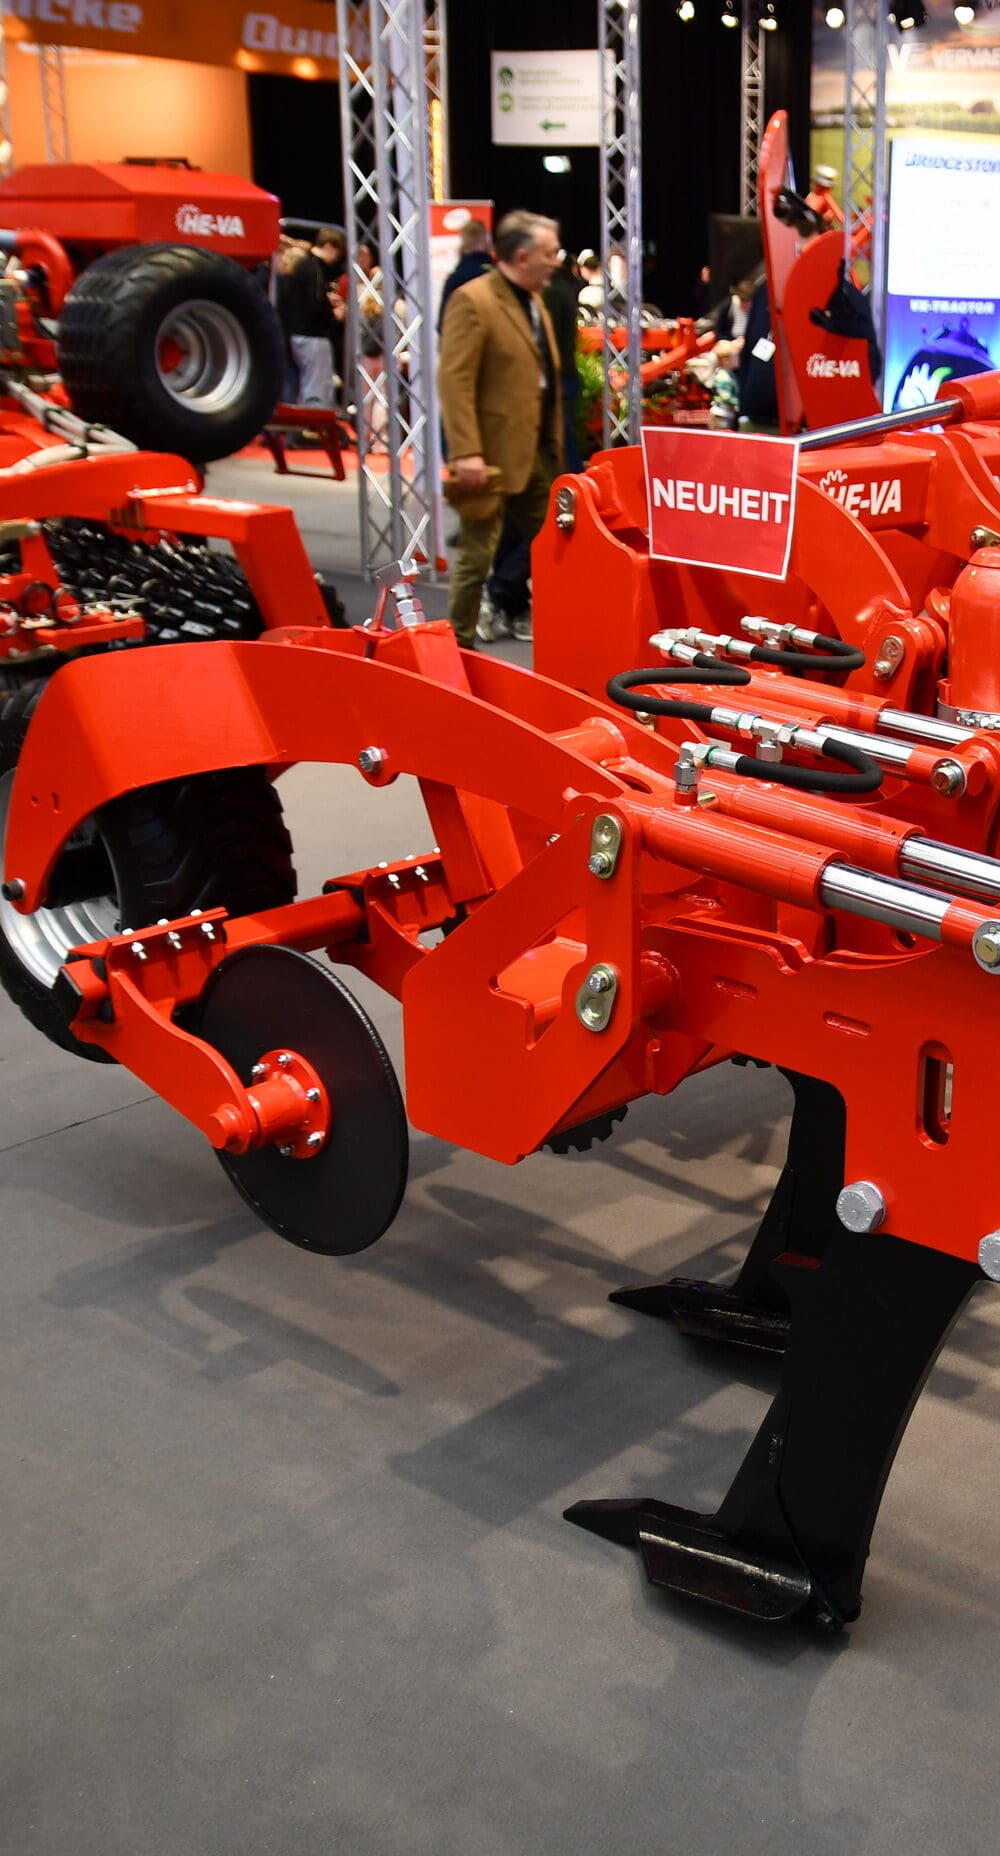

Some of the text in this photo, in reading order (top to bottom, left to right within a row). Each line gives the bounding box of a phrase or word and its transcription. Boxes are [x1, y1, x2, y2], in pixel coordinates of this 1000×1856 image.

[183, 212, 245, 238] HE-VA
[811, 359, 860, 378] HE-VA
[652, 477, 789, 524] NEUHEIT
